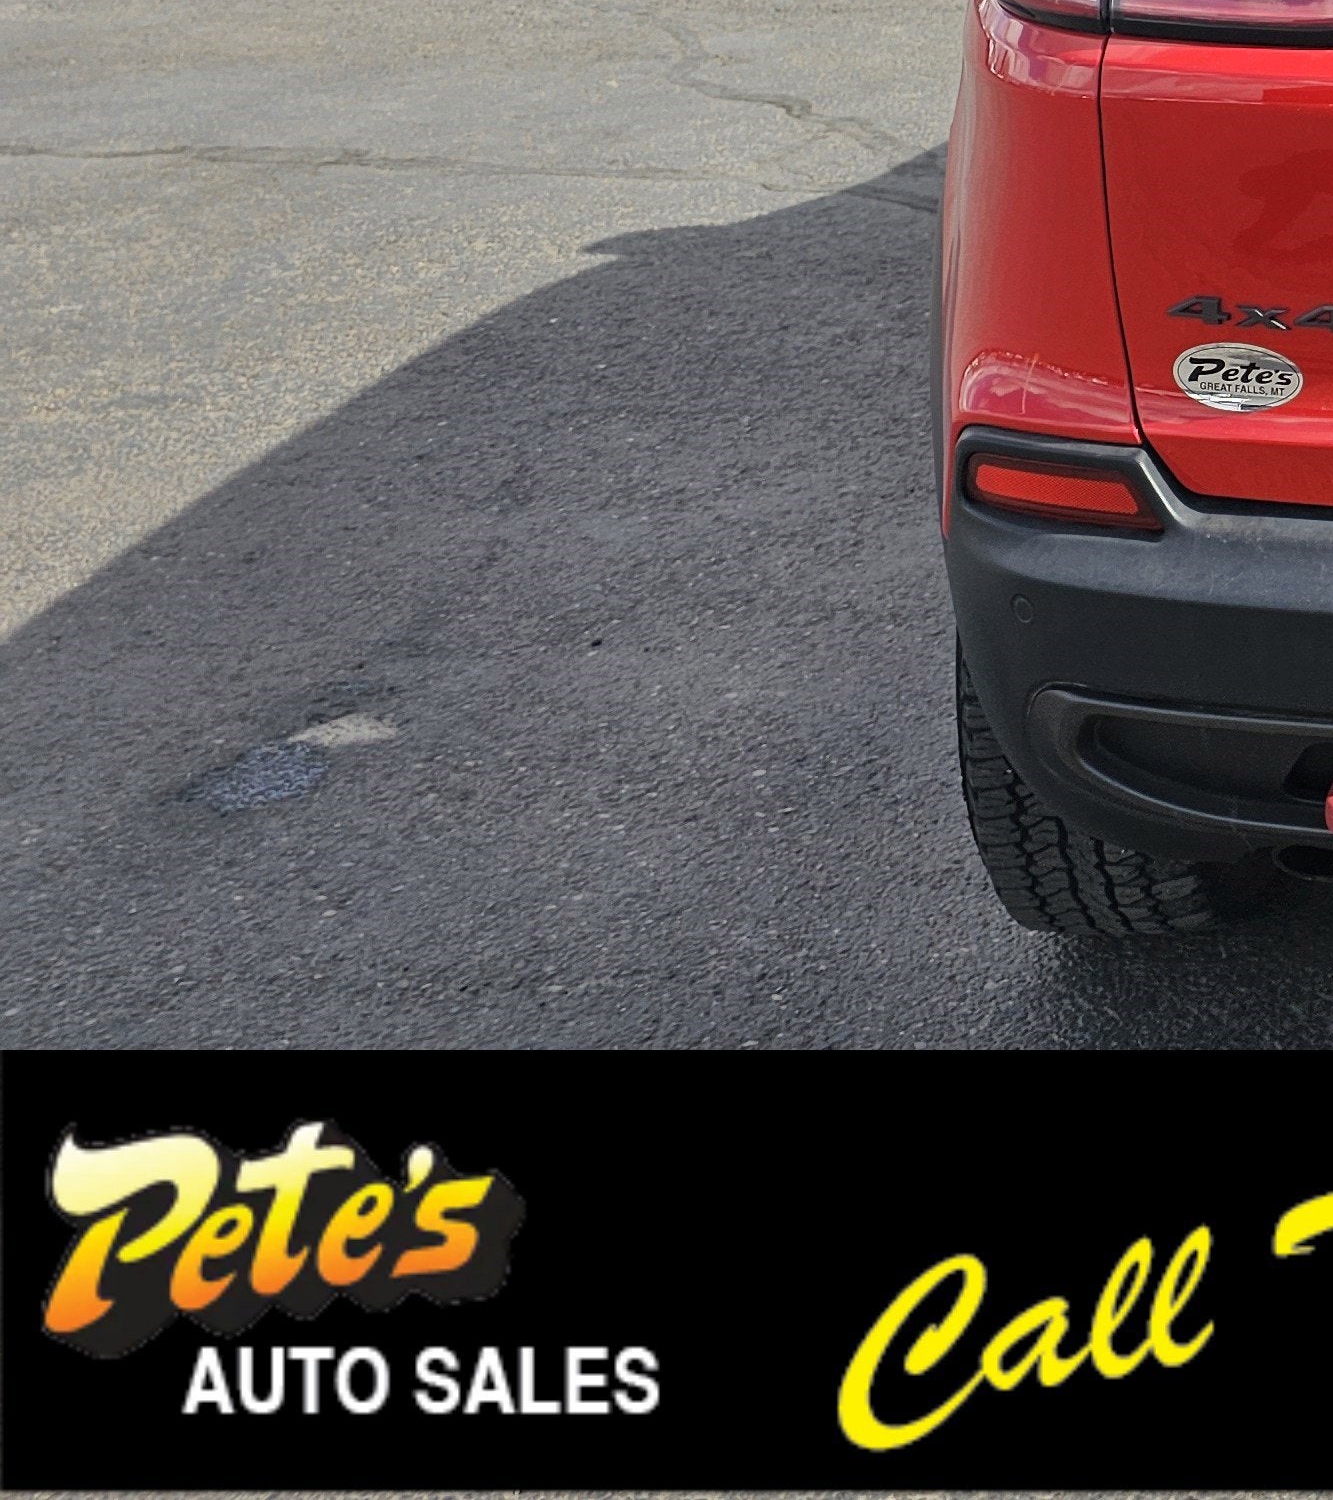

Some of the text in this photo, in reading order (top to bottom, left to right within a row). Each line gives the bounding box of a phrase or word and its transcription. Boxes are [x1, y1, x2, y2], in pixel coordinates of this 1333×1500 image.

[1187, 356, 1294, 386] Pete's
[1199, 381, 1285, 397] GREAT FALLS, MT
